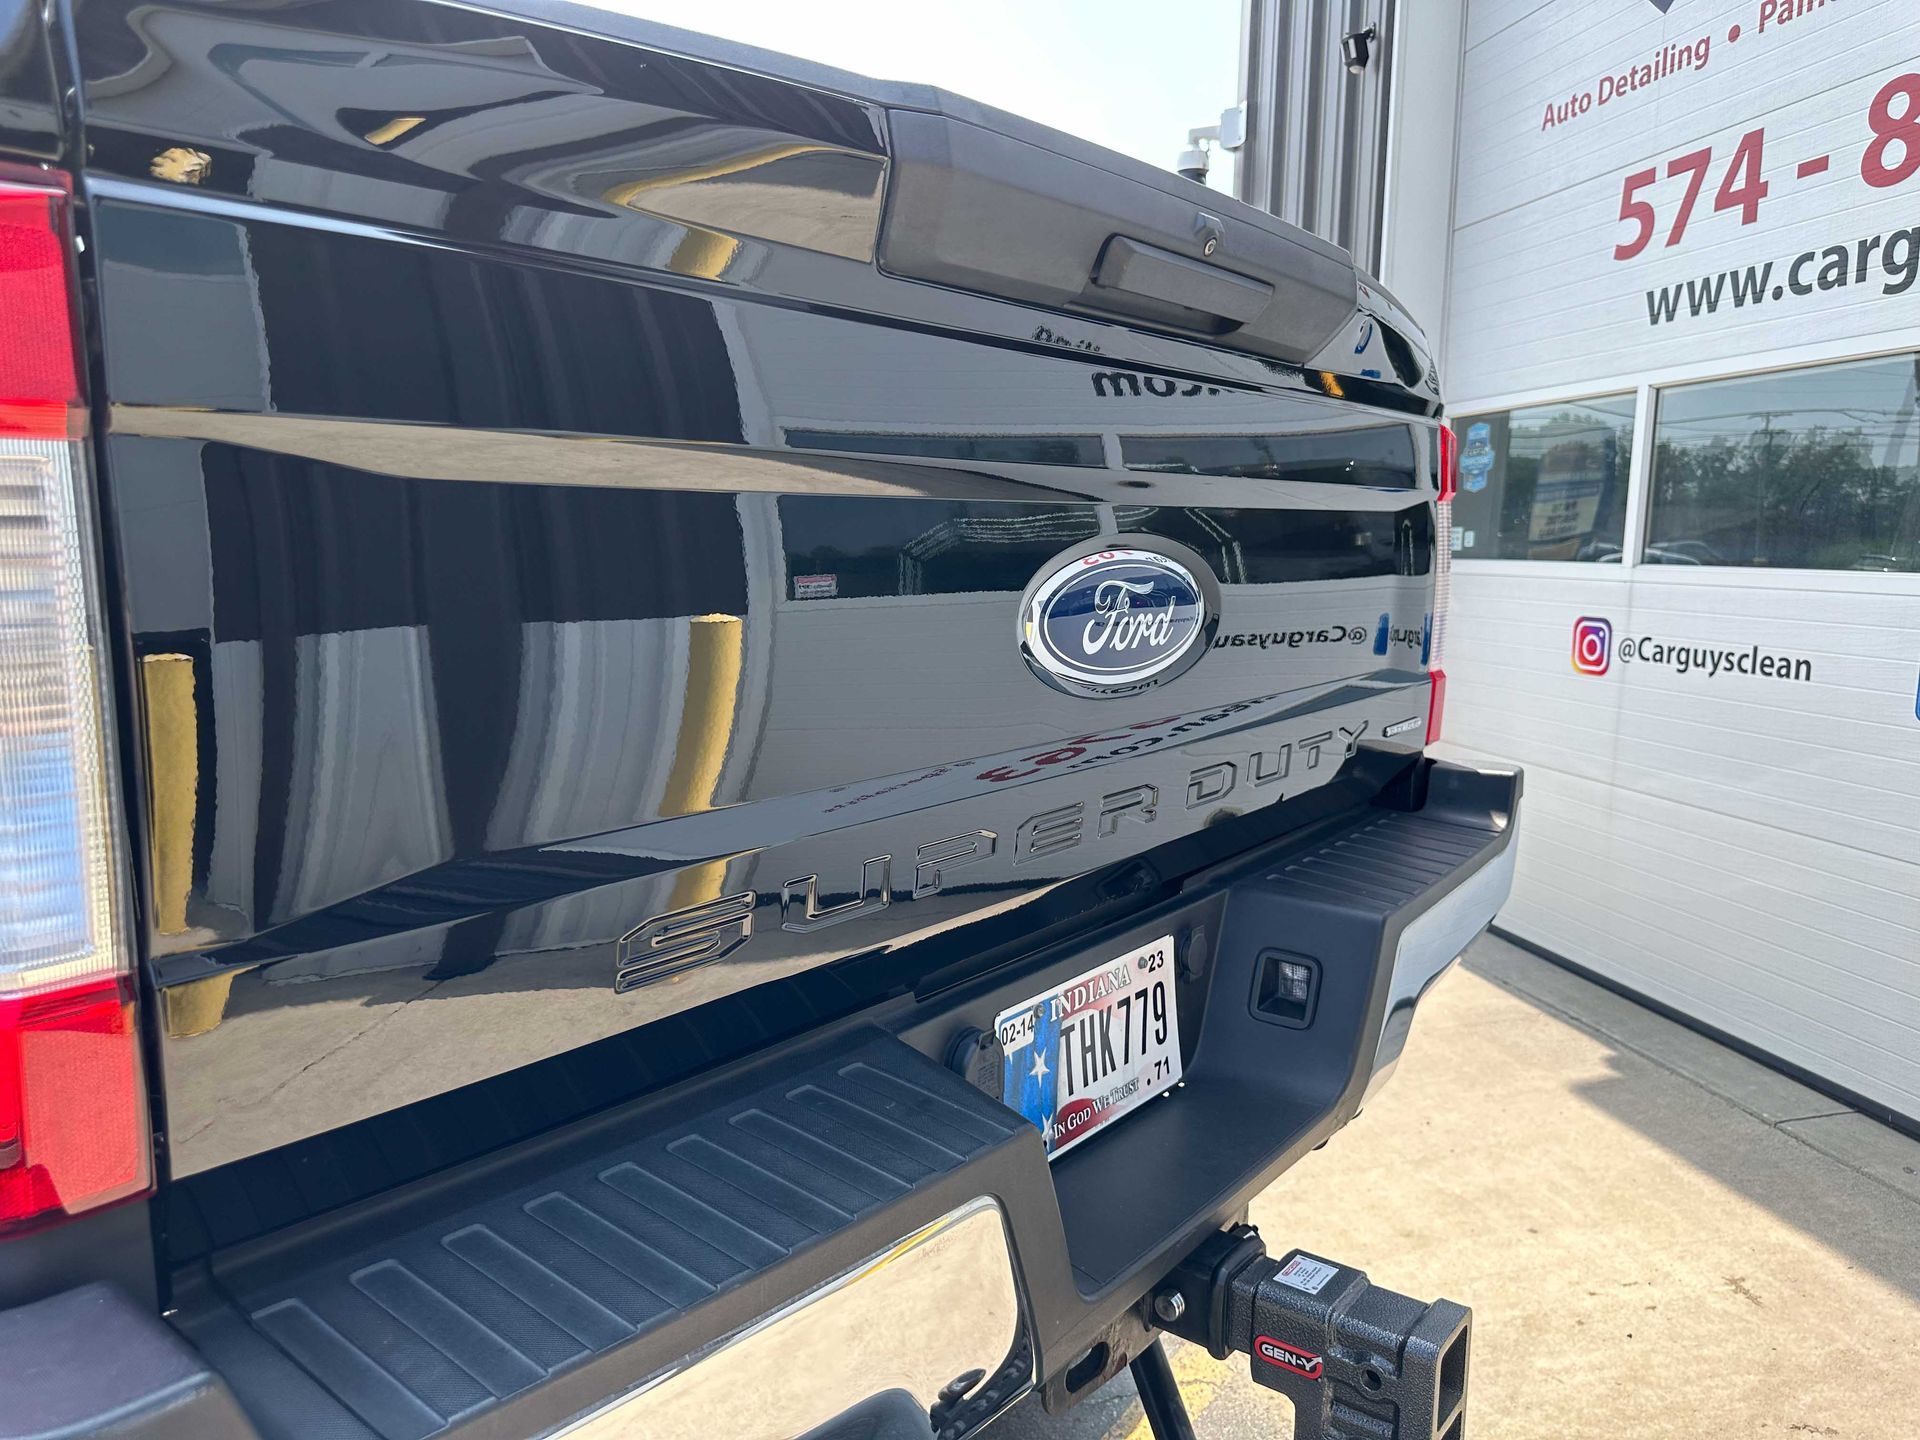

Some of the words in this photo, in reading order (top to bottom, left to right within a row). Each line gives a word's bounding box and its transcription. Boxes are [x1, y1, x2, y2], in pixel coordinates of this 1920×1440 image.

[1541, 92, 1592, 131] Auto
[1597, 36, 1710, 107] Detailing
[1613, 127, 1769, 261] 574
[1082, 580, 1176, 655] Ford
[1617, 636, 1812, 682] @Carguysclean
[614, 782, 1160, 994] SUPER
[1184, 719, 1370, 811] DUTY
[1148, 950, 1164, 973] 23
[1050, 964, 1131, 1023] INDIANA
[1002, 1014, 1034, 1046] 02-14
[1060, 980, 1168, 1097] THK779
[1154, 1056, 1170, 1080] 71
[1261, 1343, 1323, 1372] GEN-Y
